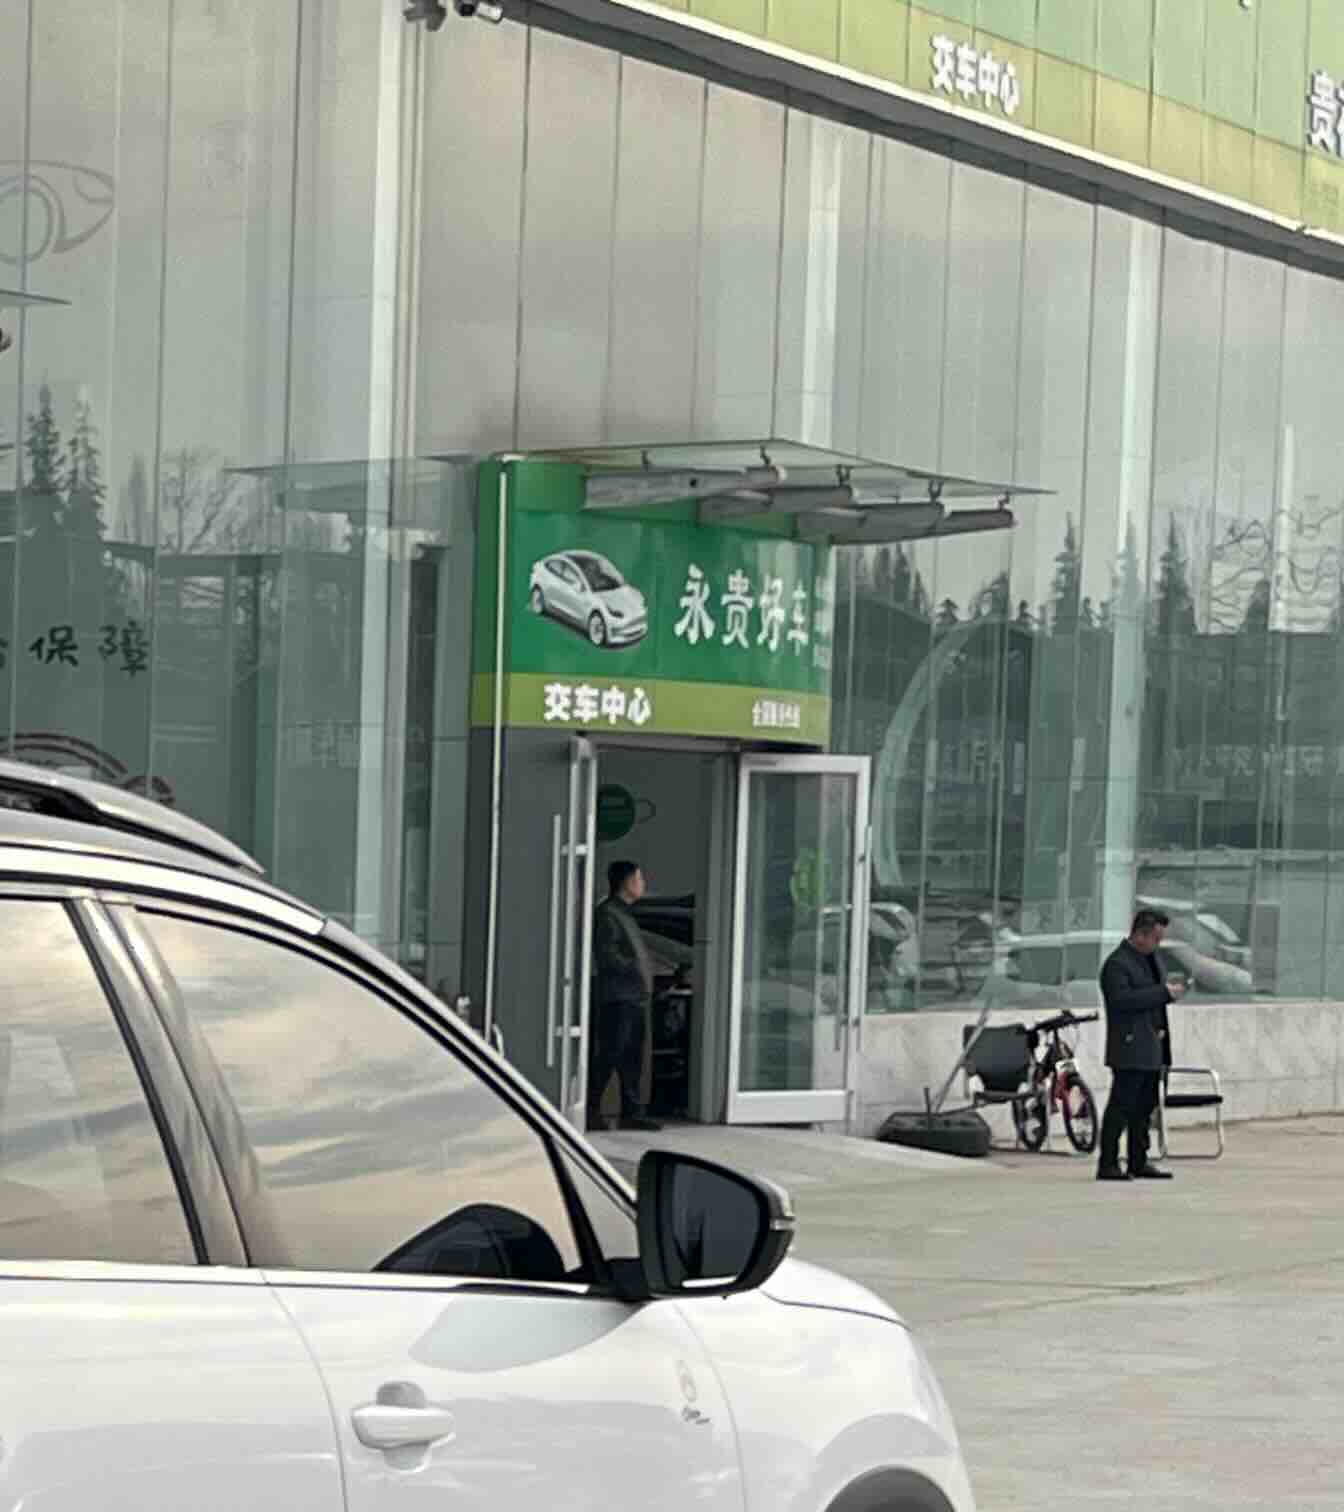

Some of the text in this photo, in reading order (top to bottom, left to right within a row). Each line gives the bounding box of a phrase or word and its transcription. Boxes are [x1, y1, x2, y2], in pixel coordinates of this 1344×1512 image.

[929, 32, 1021, 117] 交车中心
[673, 563, 810, 656] 永贵好车
[543, 682, 653, 726] 交车中心
